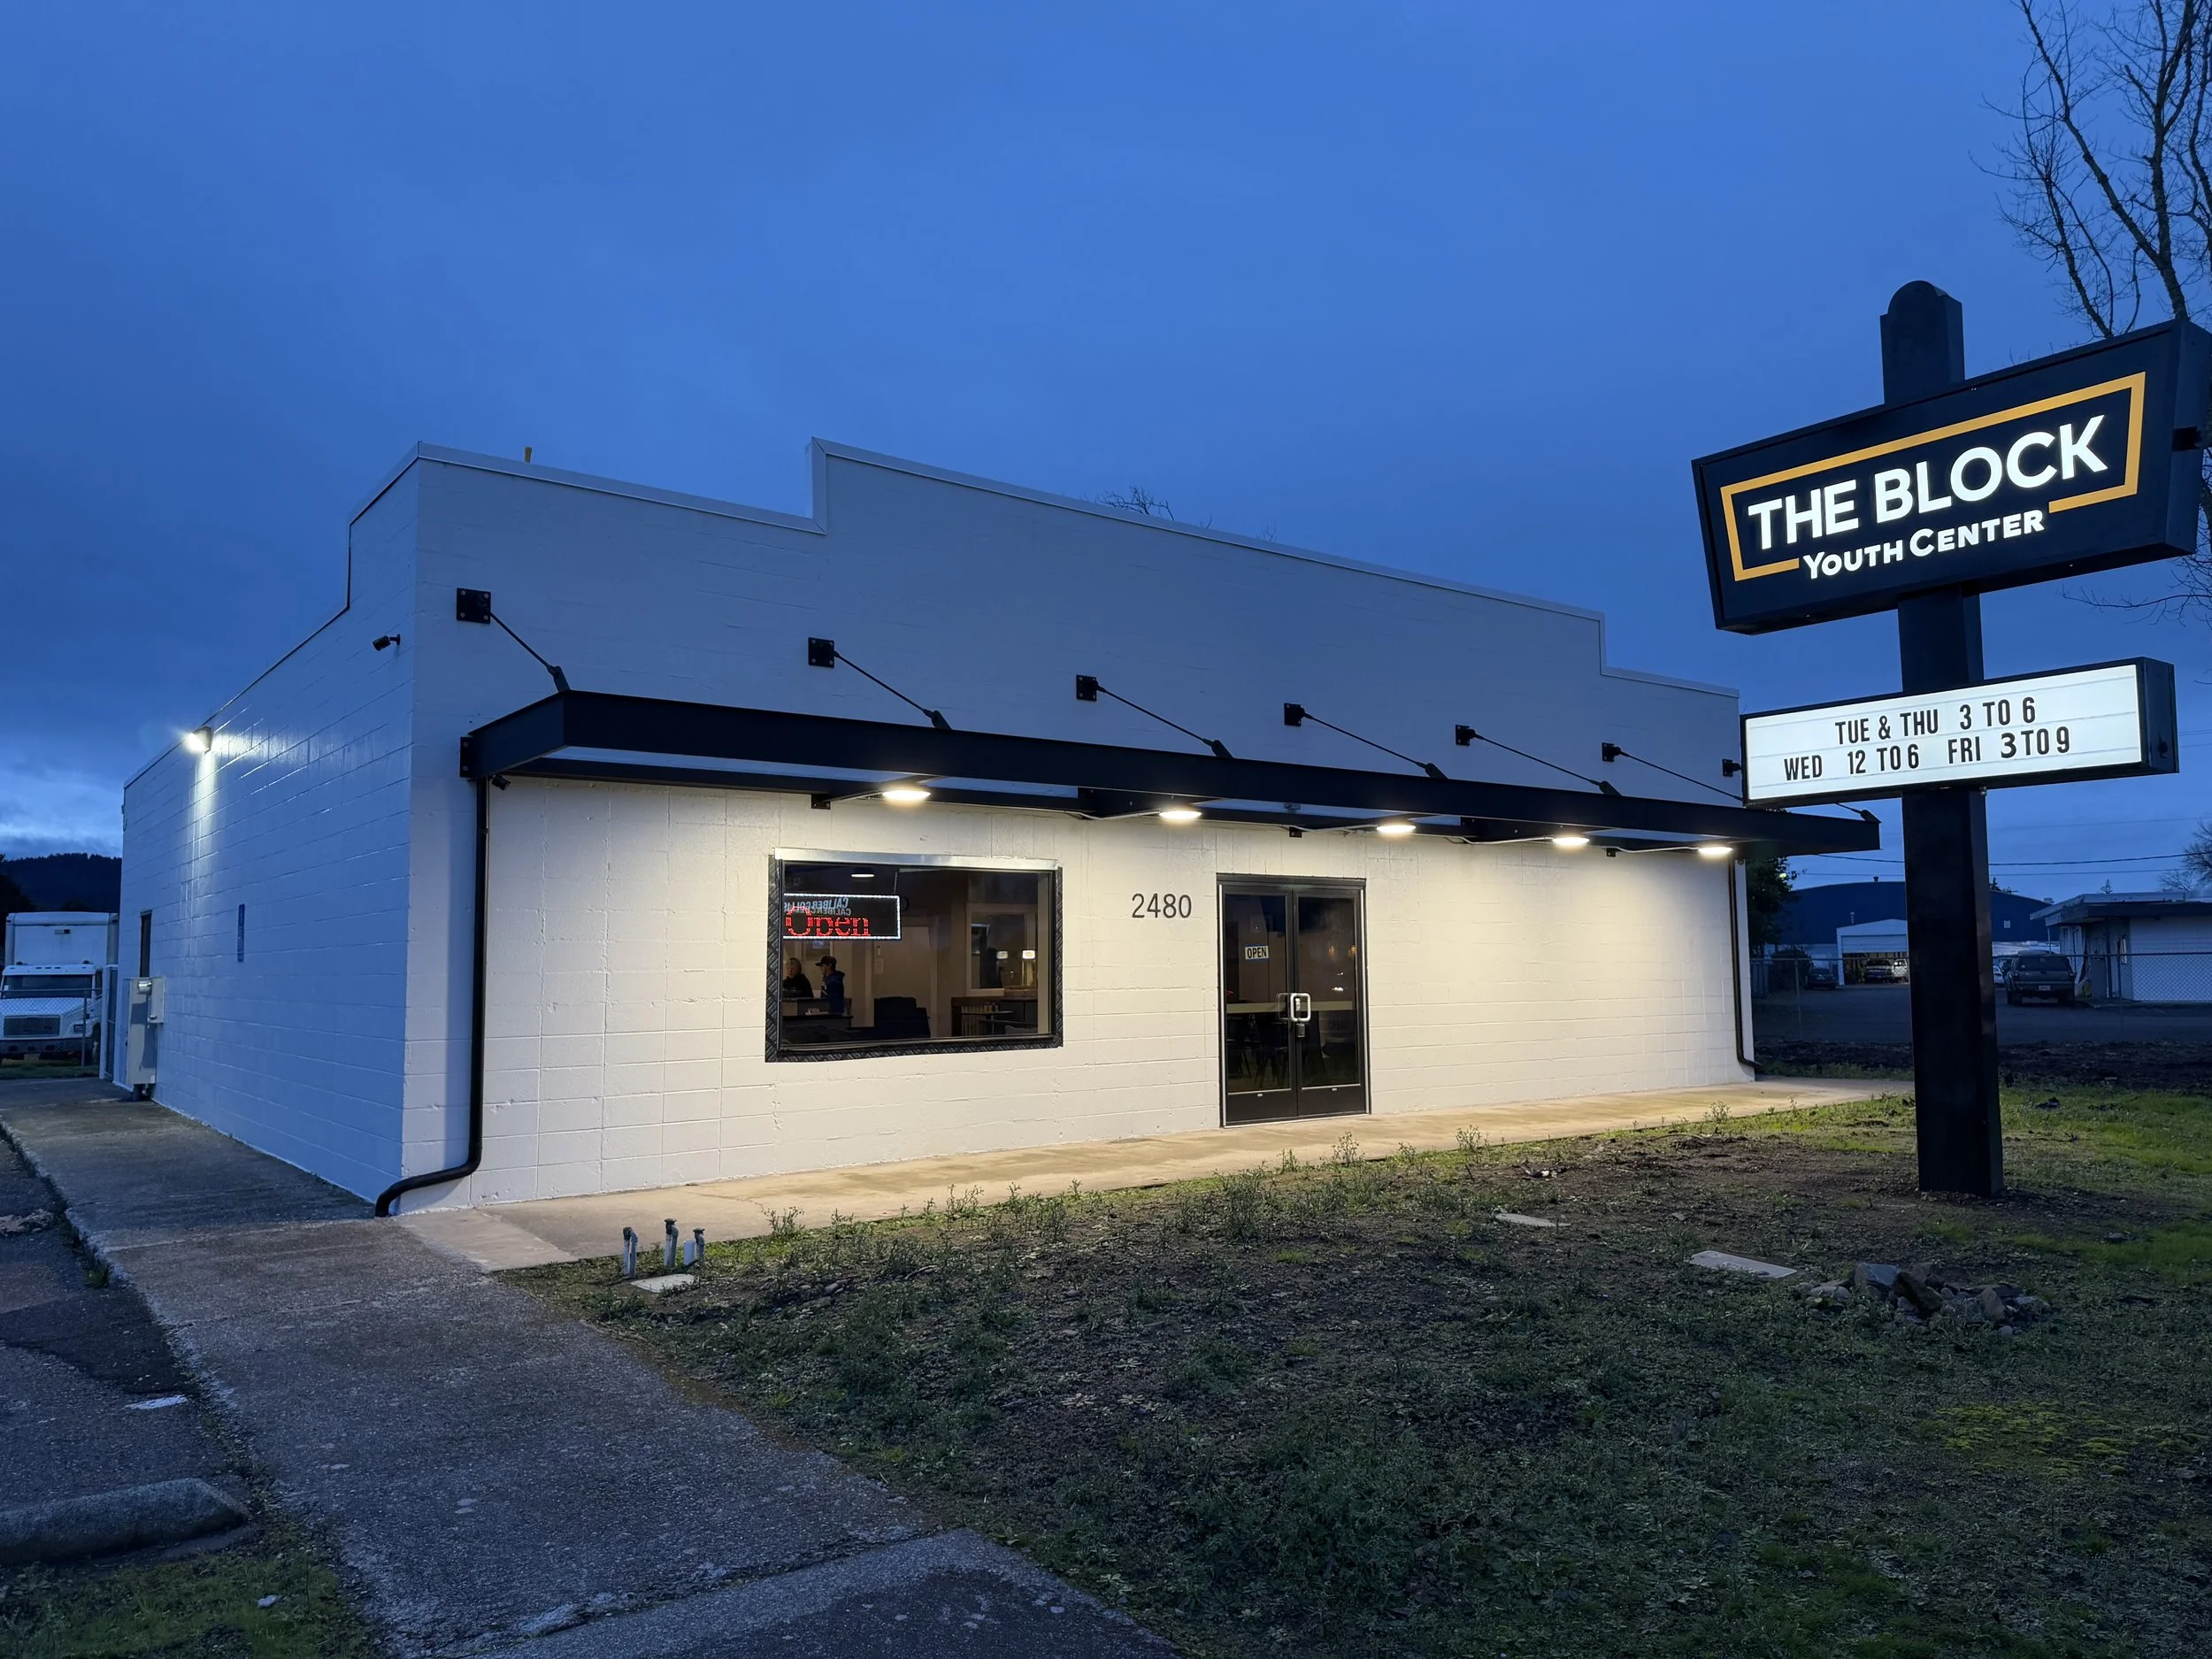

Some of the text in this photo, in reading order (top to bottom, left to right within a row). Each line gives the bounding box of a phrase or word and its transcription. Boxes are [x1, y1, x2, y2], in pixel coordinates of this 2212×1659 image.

[1748, 414, 2108, 549] THE BLOCK
[1802, 510, 2045, 580] YOUTH CENTER
[1835, 696, 2036, 745] TUE & THU 3 TO 6
[1784, 755, 1823, 781] WED
[1847, 749, 1866, 775] 12
[1947, 735, 1981, 764] FRI
[785, 906, 871, 937] Open
[1132, 893, 1192, 918] 2480
[1247, 947, 1266, 958] OPEN
